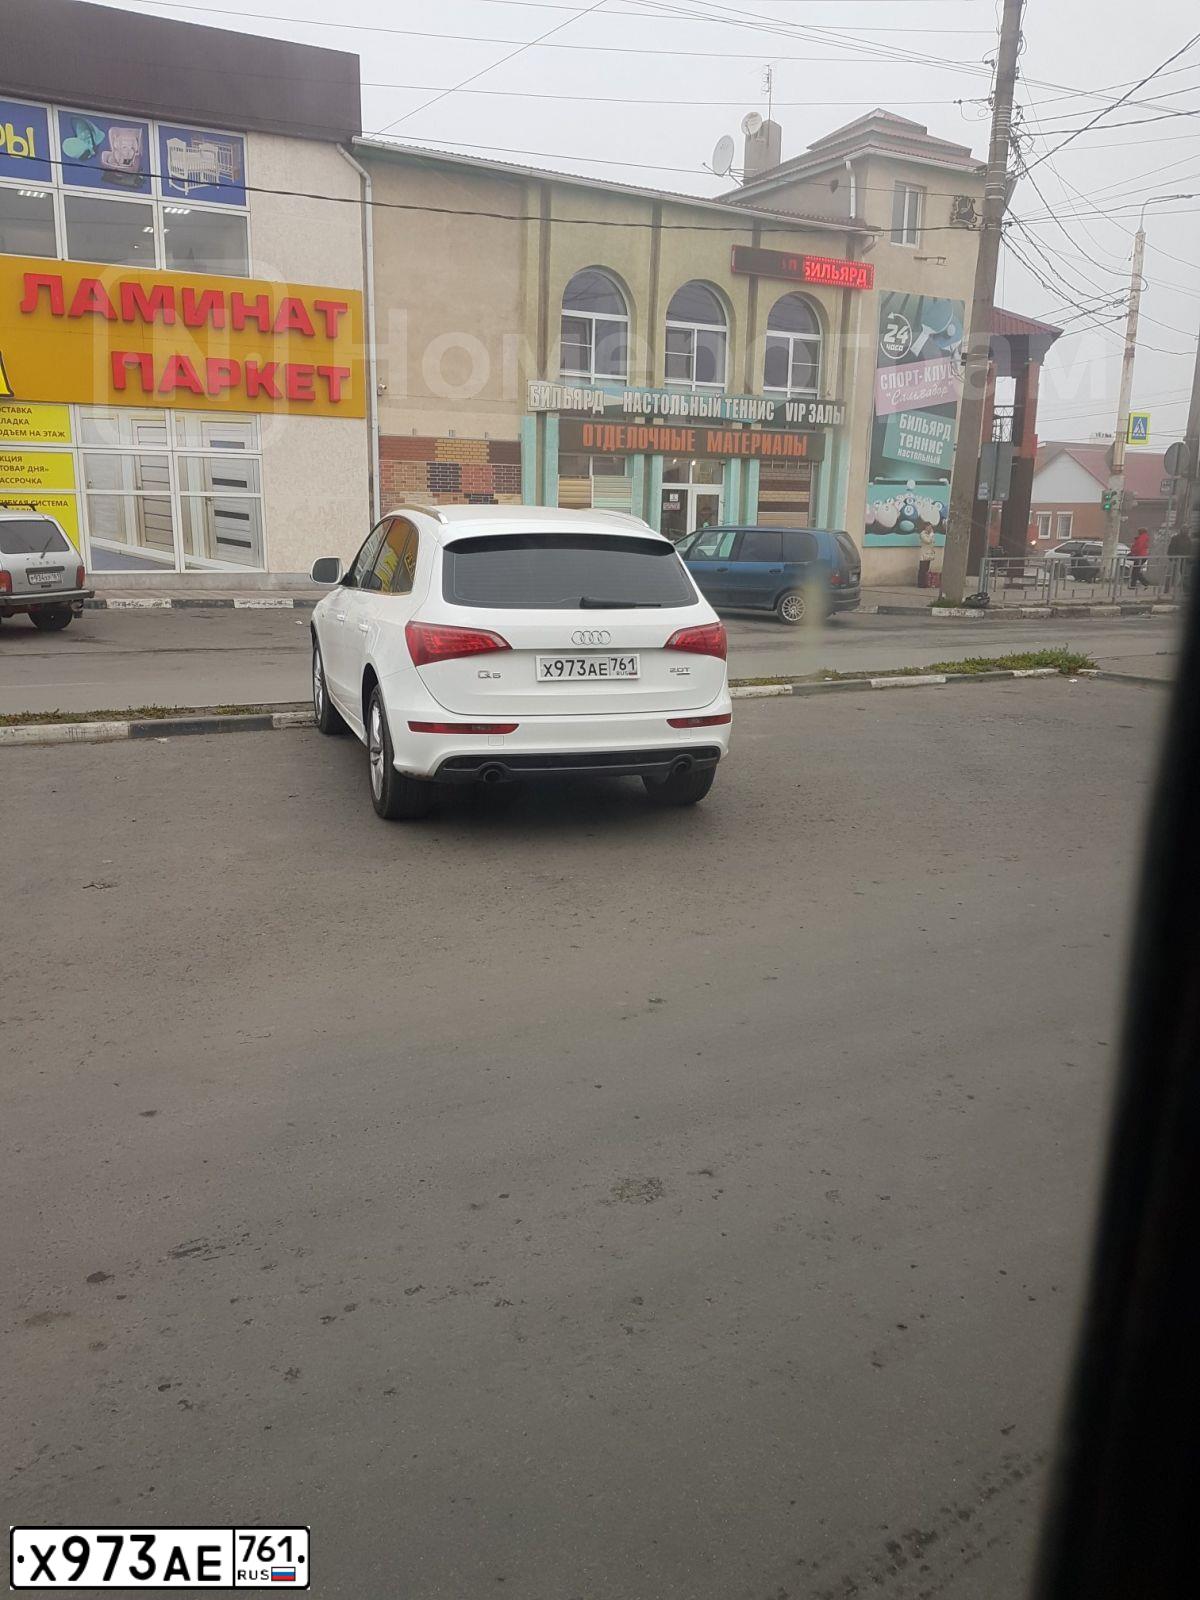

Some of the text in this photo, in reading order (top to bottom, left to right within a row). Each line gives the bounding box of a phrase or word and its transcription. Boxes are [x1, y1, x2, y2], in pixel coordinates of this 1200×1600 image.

[20, 273, 348, 338] ЛАМИНАТ
[884, 324, 909, 344] 24
[111, 351, 350, 403] ПАРКЕТ
[530, 385, 845, 424] БИЛЬЯРД НАСТОЛЬНЫЙ ТЕННИС VIP ЗАЛЫ
[582, 423, 807, 456] ОТДЕЛОЧНЫЕ МАТЕРИАЛЫ
[900, 413, 951, 441] БИЛЬЯРД
[543, 658, 635, 677] Х973АЕ 761
